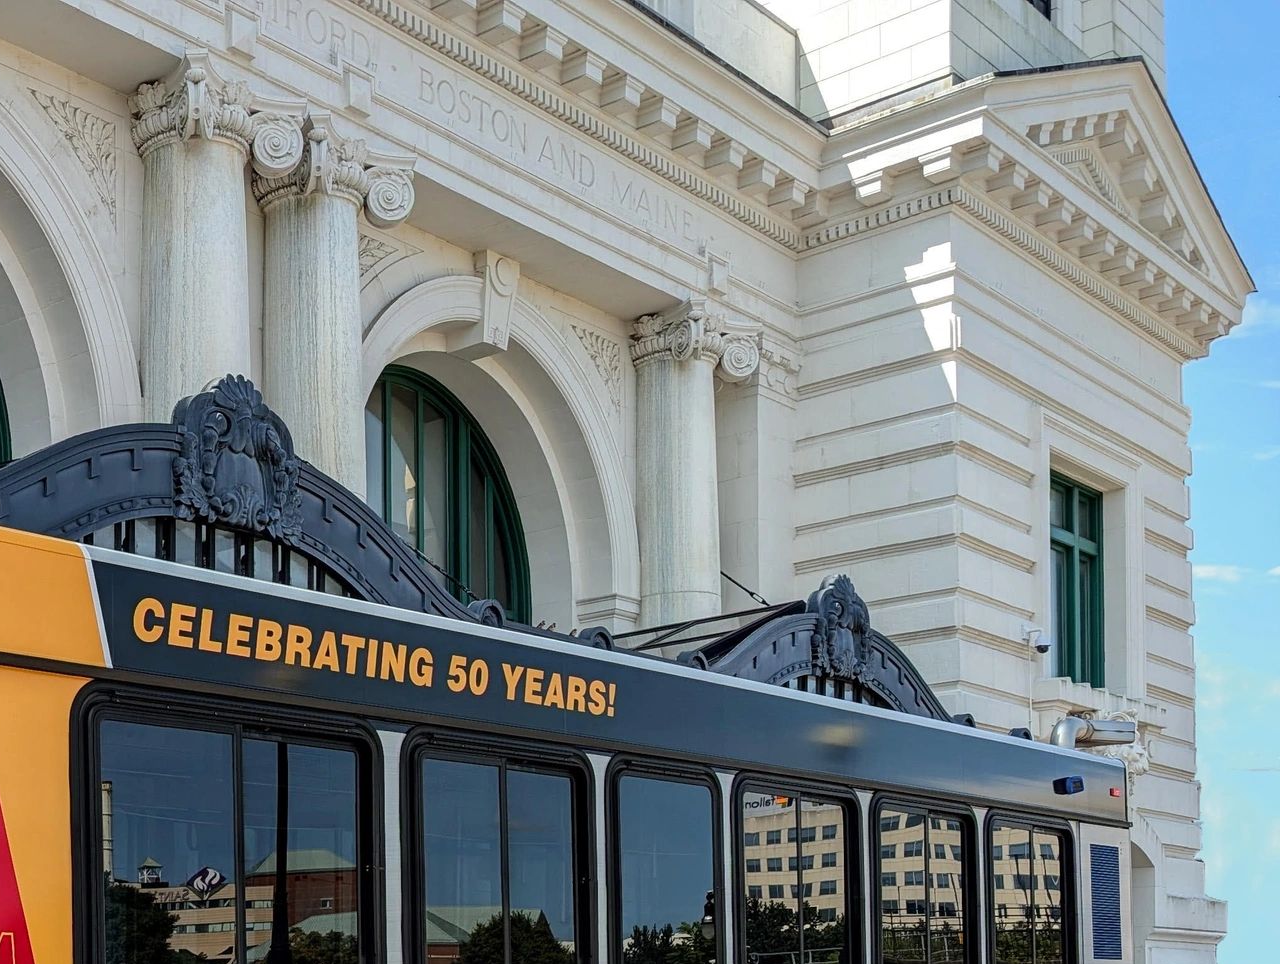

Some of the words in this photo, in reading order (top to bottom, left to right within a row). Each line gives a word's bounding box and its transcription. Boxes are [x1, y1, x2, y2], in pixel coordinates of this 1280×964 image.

[418, 66, 528, 155] BOSTON
[536, 134, 596, 188] AND
[609, 170, 695, 236] MAINE
[132, 597, 434, 688] CELEBRATING
[446, 654, 489, 697] 50
[501, 662, 616, 718] YEARS!
